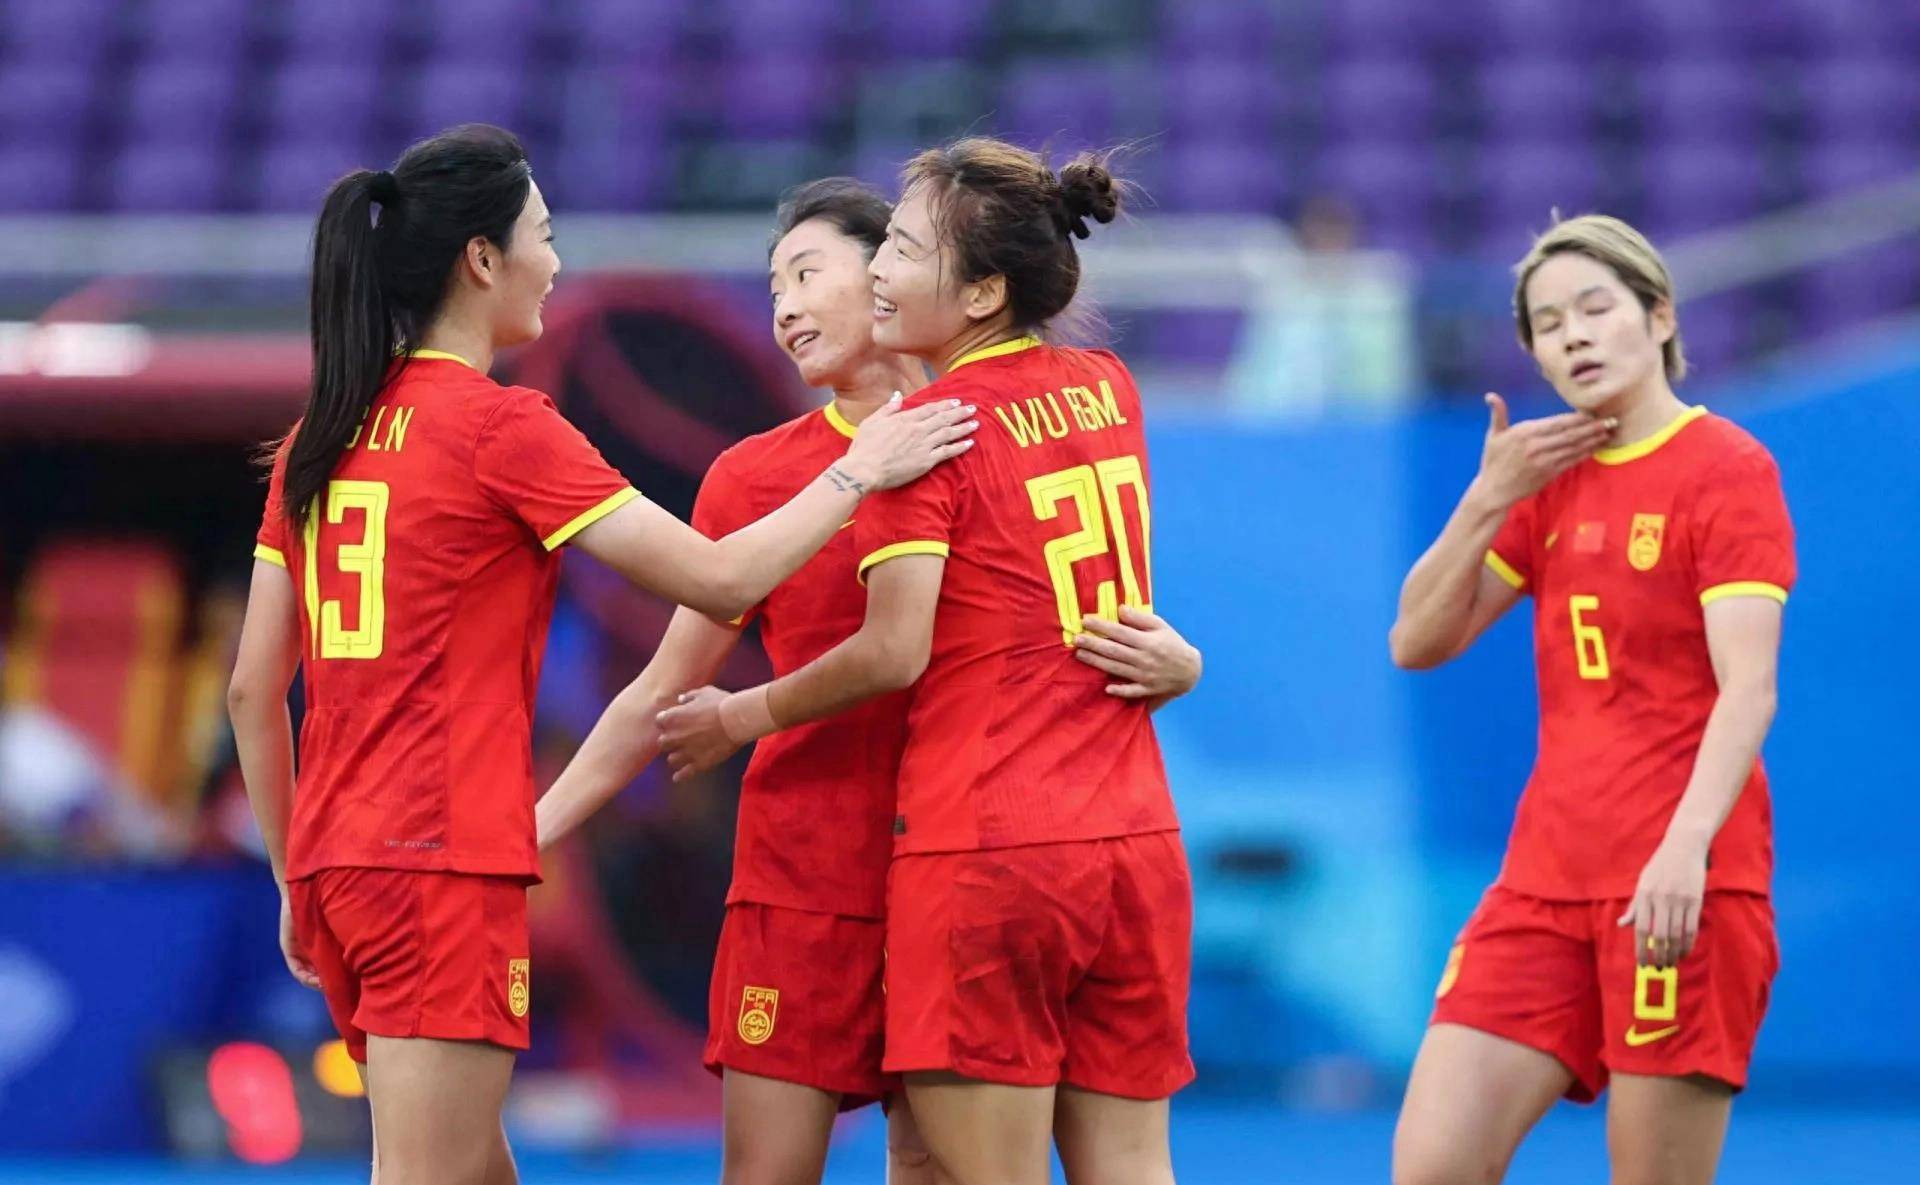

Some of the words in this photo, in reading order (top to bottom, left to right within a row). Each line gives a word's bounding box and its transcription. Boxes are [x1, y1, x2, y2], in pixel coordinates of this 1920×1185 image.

[367, 405, 416, 453] LN
[994, 391, 1069, 448] WU
[304, 480, 390, 661] 13
[1025, 455, 1153, 647] 20
[1569, 594, 1610, 680] 6
[746, 989, 775, 1004] CFA
